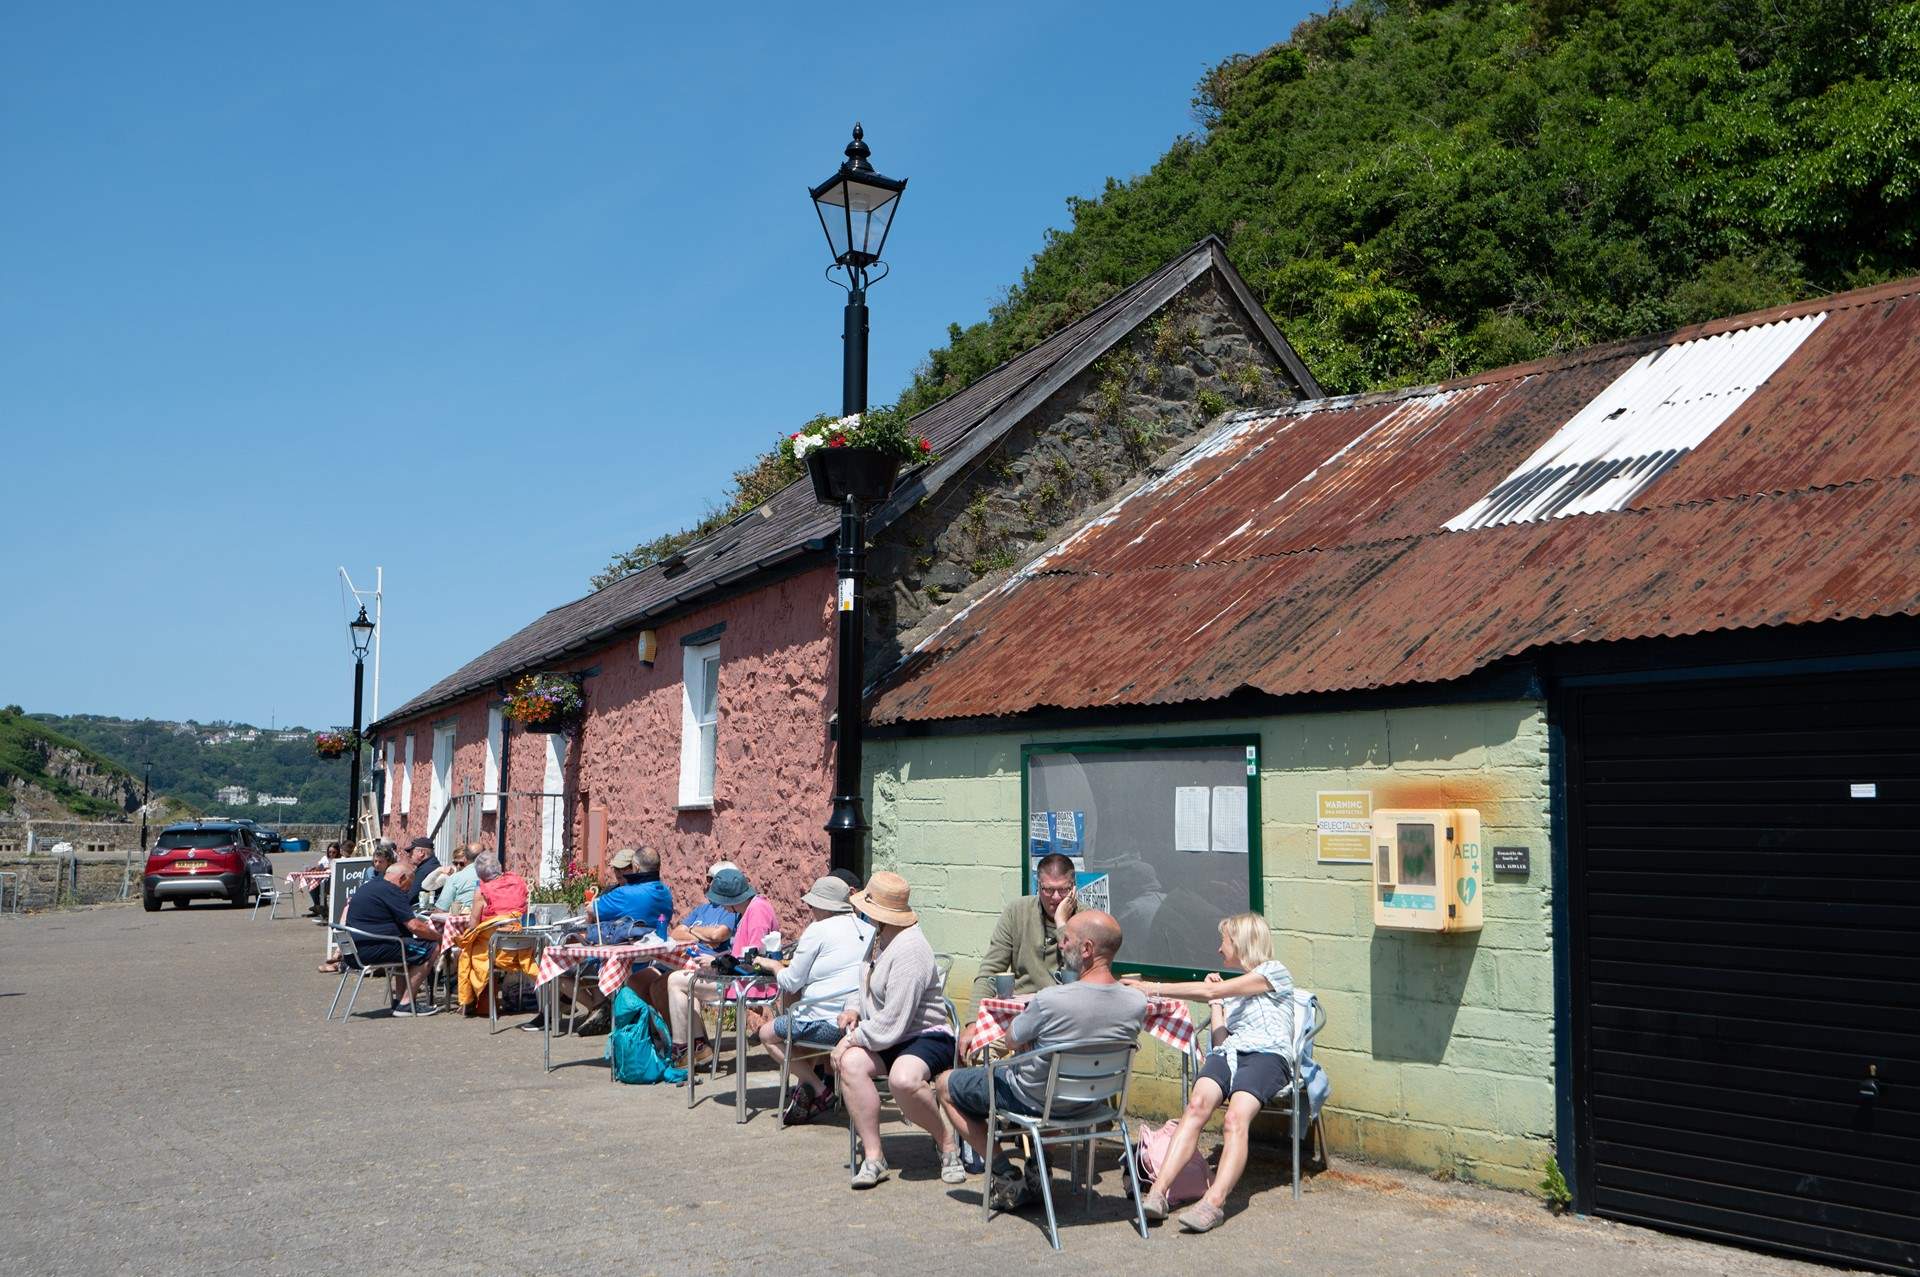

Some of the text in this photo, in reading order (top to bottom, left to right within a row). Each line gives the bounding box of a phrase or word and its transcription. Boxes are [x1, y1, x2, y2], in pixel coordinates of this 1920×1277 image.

[1325, 800, 1362, 808] WARNING
[1057, 811, 1073, 820] BOATS
[1453, 844, 1478, 859] AED
[343, 868, 366, 882] local
